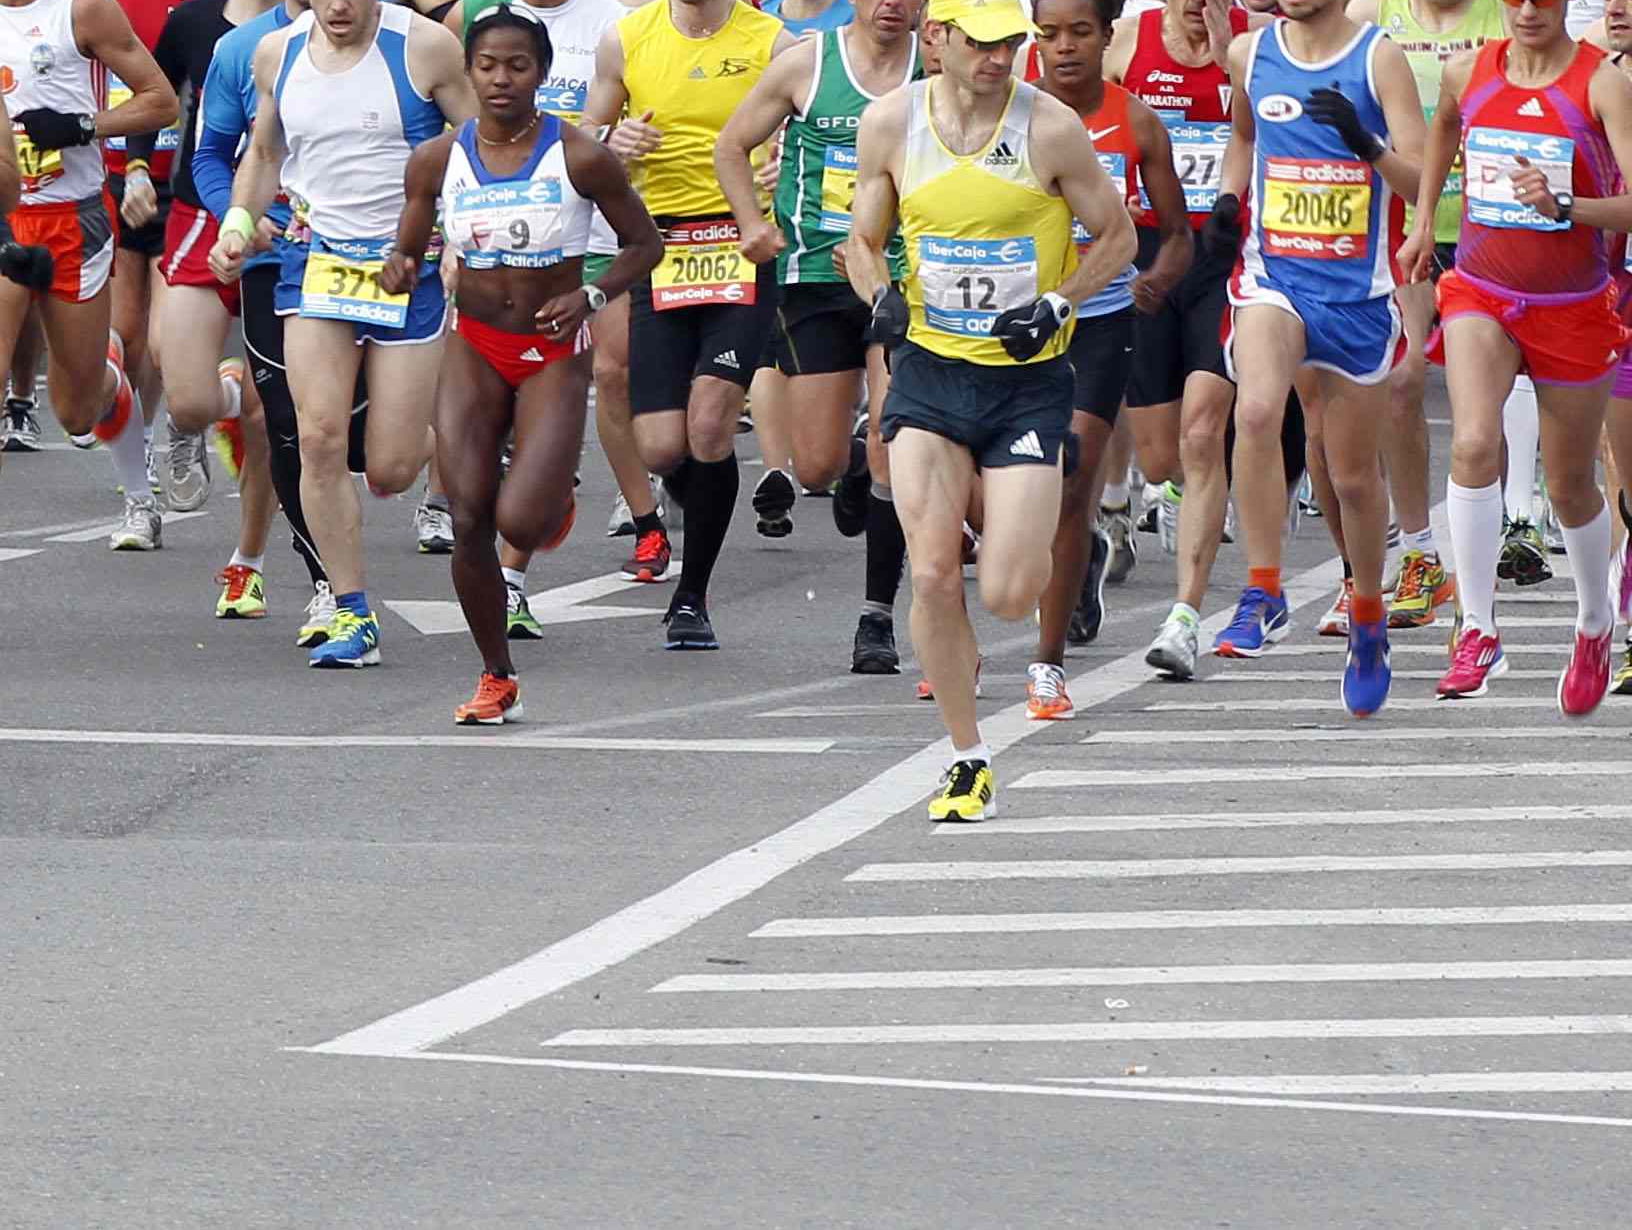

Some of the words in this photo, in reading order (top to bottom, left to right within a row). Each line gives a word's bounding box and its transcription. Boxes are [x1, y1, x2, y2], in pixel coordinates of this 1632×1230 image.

[1146, 69, 1184, 83] asics
[1142, 94, 1192, 107] MARATHON
[1180, 154, 1216, 185] 27
[1303, 164, 1366, 183] adidas
[1280, 191, 1353, 228] 20046
[509, 219, 531, 250] 9
[672, 254, 740, 283] 20062
[955, 276, 997, 310] 12
[341, 302, 401, 323] adidas
